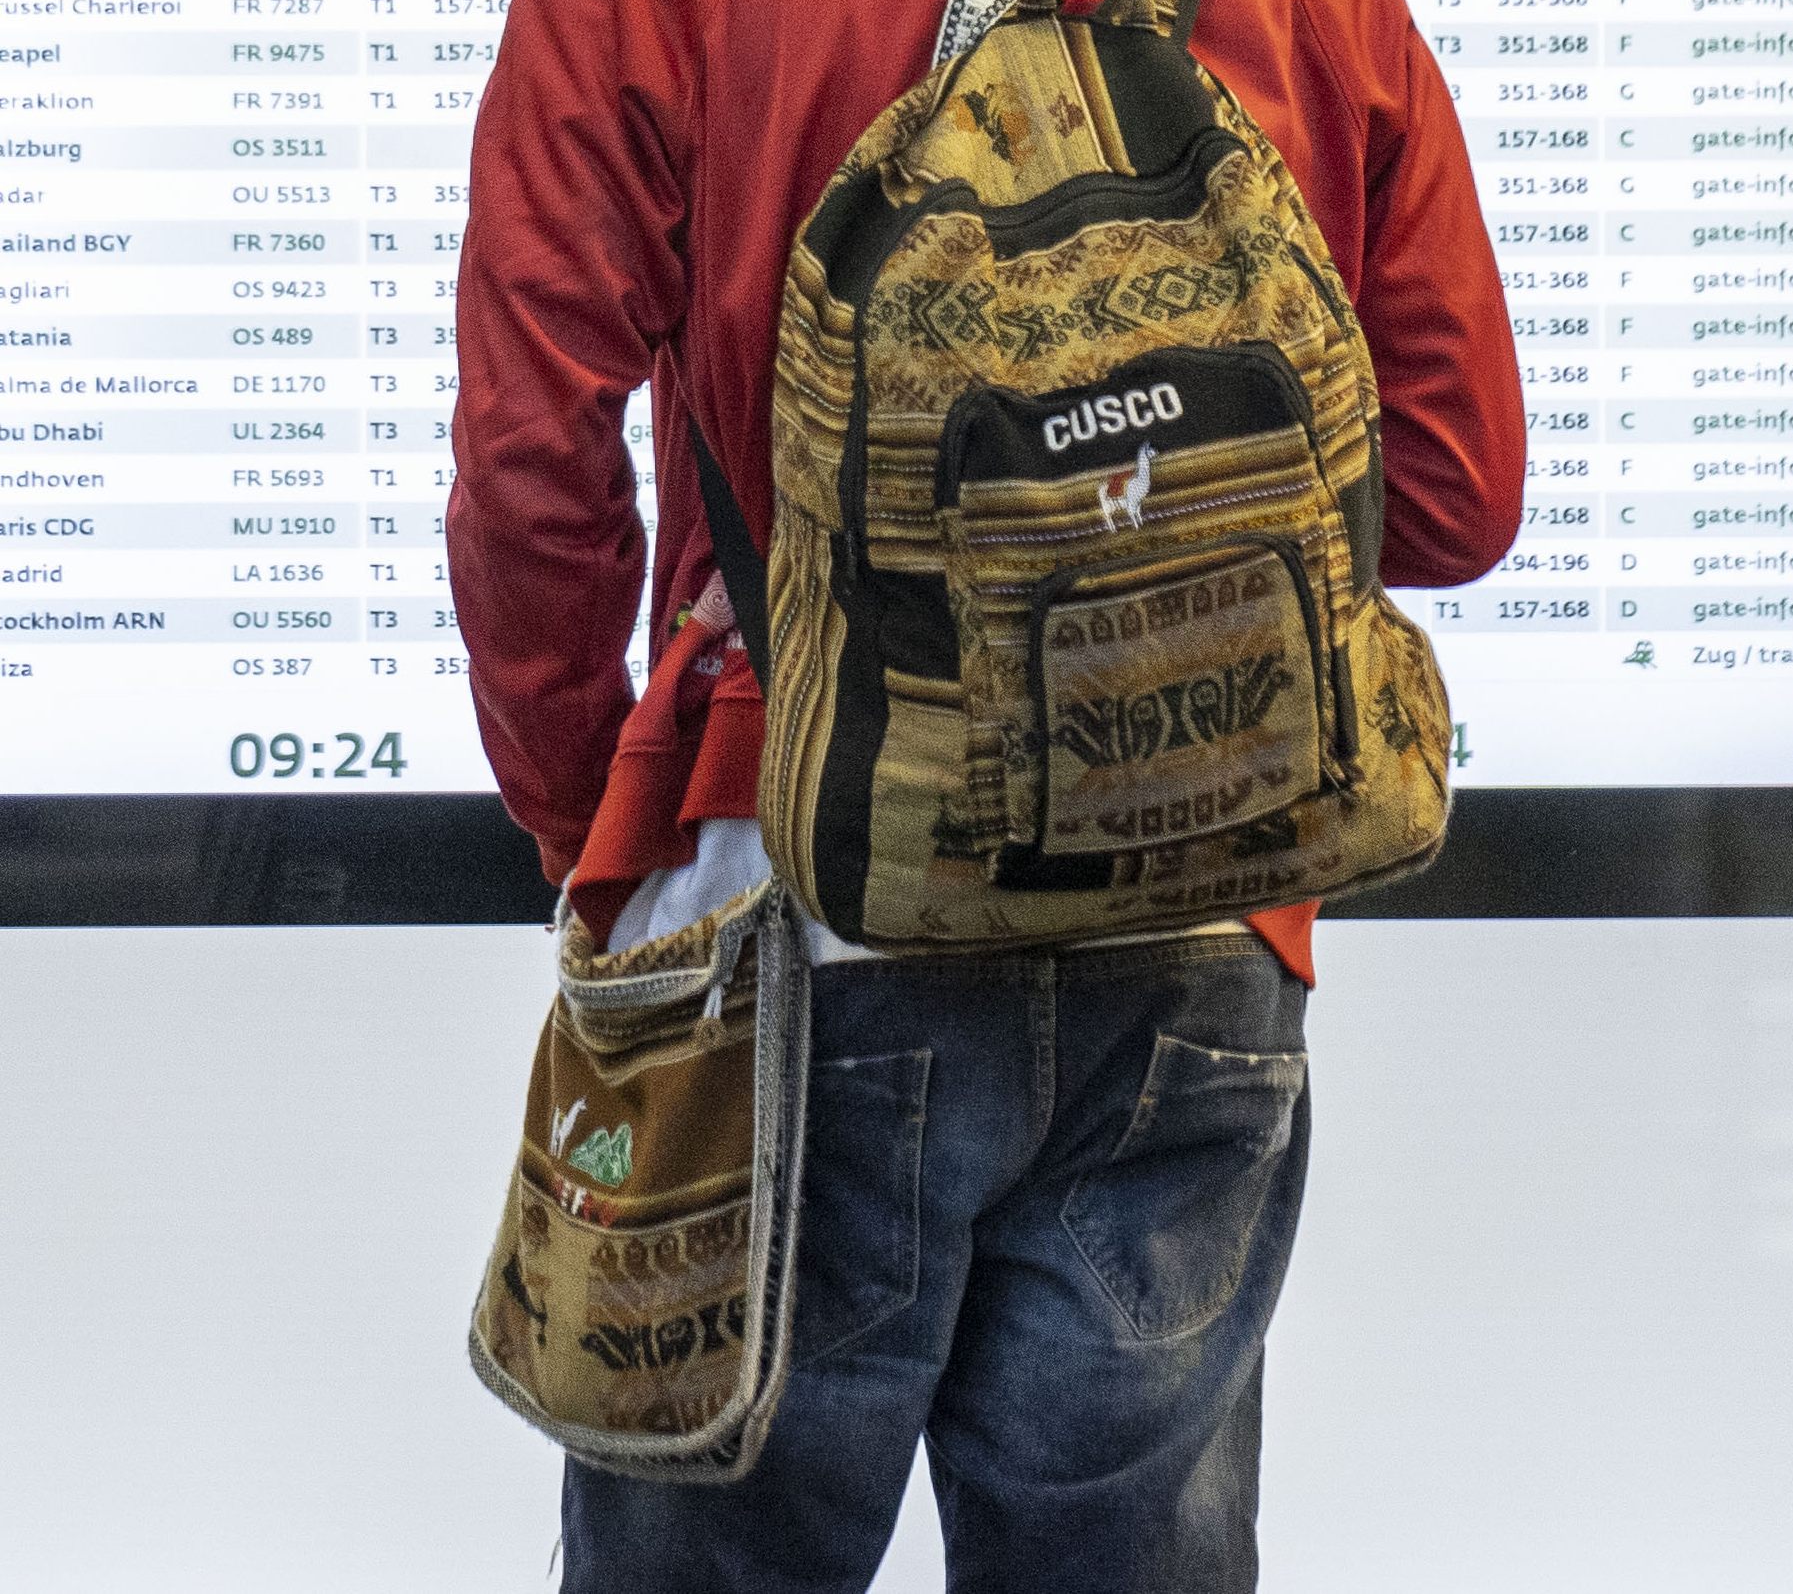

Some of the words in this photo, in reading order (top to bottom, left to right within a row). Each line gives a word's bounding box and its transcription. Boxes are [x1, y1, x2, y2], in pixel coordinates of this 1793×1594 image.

[232, 43, 264, 63] FR
[268, 43, 325, 63] 9475
[369, 43, 399, 62] T1
[231, 138, 266, 158] OS
[271, 138, 327, 158] 3511
[1498, 129, 1589, 149] 157-168
[1618, 128, 1635, 149] C
[83, 233, 132, 253] BGY
[232, 233, 264, 252] FR
[269, 233, 326, 252] 7360
[368, 232, 399, 252] T1
[1497, 224, 1590, 244] 157-168
[1618, 223, 1635, 243] C
[231, 327, 266, 346] OS
[270, 326, 314, 346] 489
[368, 326, 399, 346] T3
[1043, 382, 1184, 452] CUSCO
[32, 421, 104, 442] Dhabi
[232, 422, 265, 441] UL
[269, 421, 326, 441] 2364
[368, 421, 399, 441] T3
[43, 517, 95, 537] CDG
[232, 517, 273, 536] MU
[280, 516, 336, 536] 1910
[369, 516, 399, 535] T1
[112, 611, 165, 630] ARN
[231, 610, 270, 630] OU
[276, 610, 333, 630] 5560
[368, 609, 399, 629] T3
[1434, 601, 1464, 620] T1
[1498, 600, 1590, 620] 157-168
[1620, 599, 1639, 619] D
[229, 732, 408, 779] 09:24
